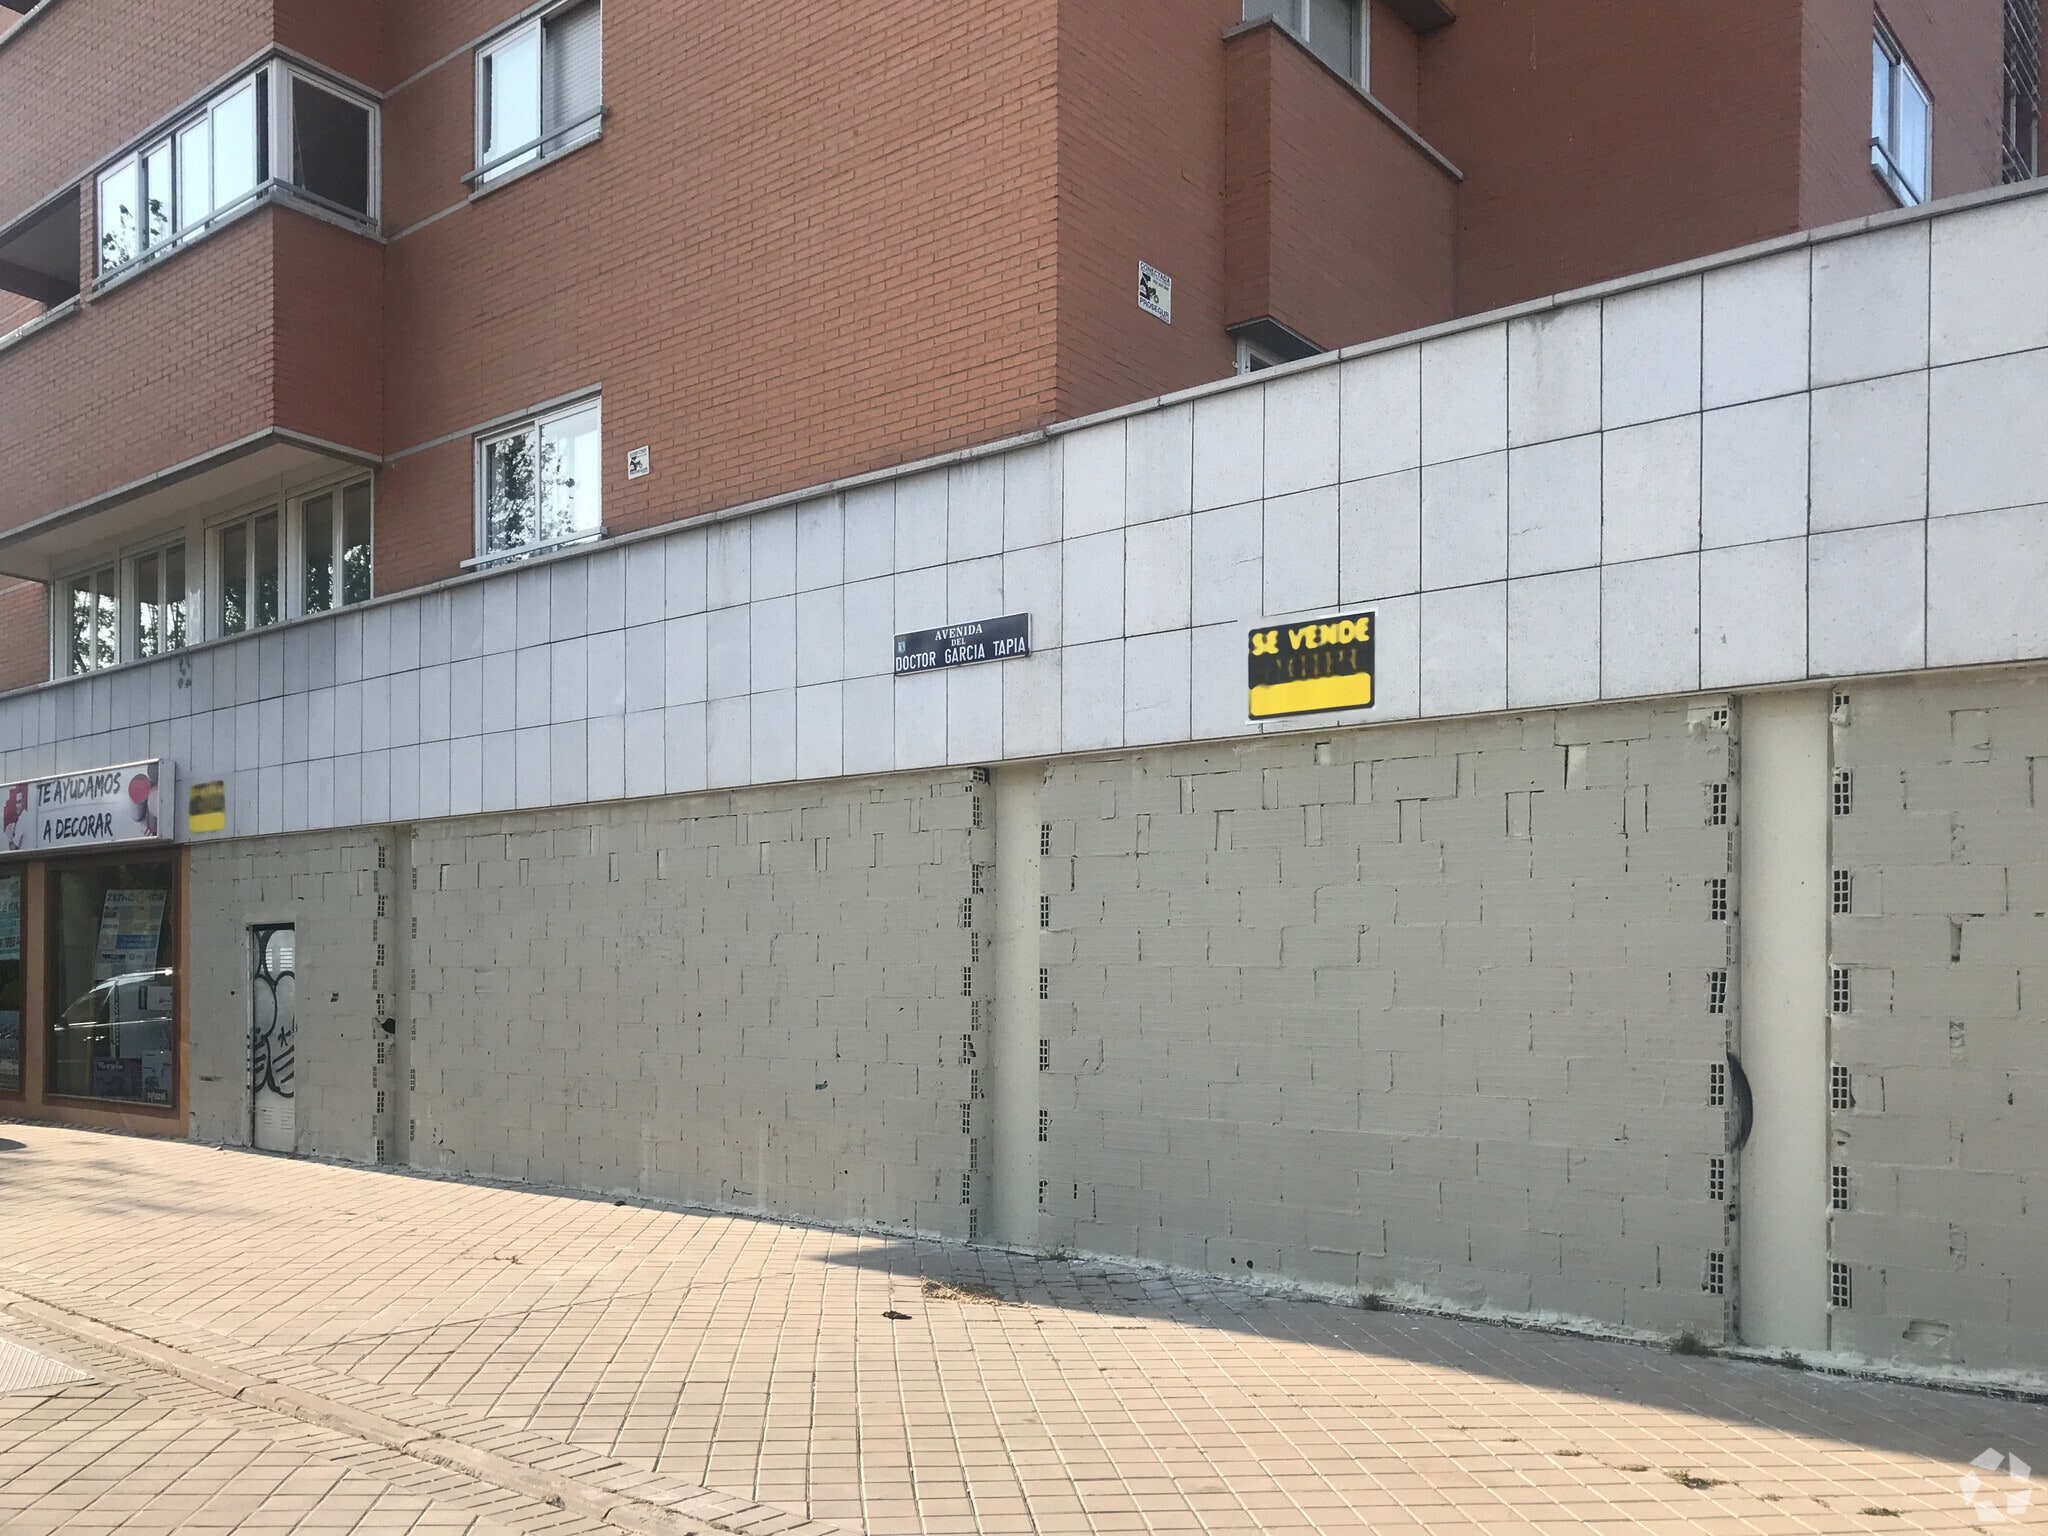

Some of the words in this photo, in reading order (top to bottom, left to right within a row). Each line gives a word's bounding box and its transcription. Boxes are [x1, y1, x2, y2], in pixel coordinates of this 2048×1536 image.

[935, 624, 983, 641] AVENIDA
[951, 637, 966, 647] DEL
[1252, 630, 1279, 656] SE
[1288, 617, 1370, 650] VENDE
[895, 651, 936, 672] DOCTOR
[944, 643, 985, 664] GARCIA
[992, 636, 1026, 657] TAPIA
[36, 782, 52, 807] TE
[53, 772, 122, 804] AYUDAMOS
[43, 819, 53, 843] A
[55, 812, 113, 840] DECORAR
